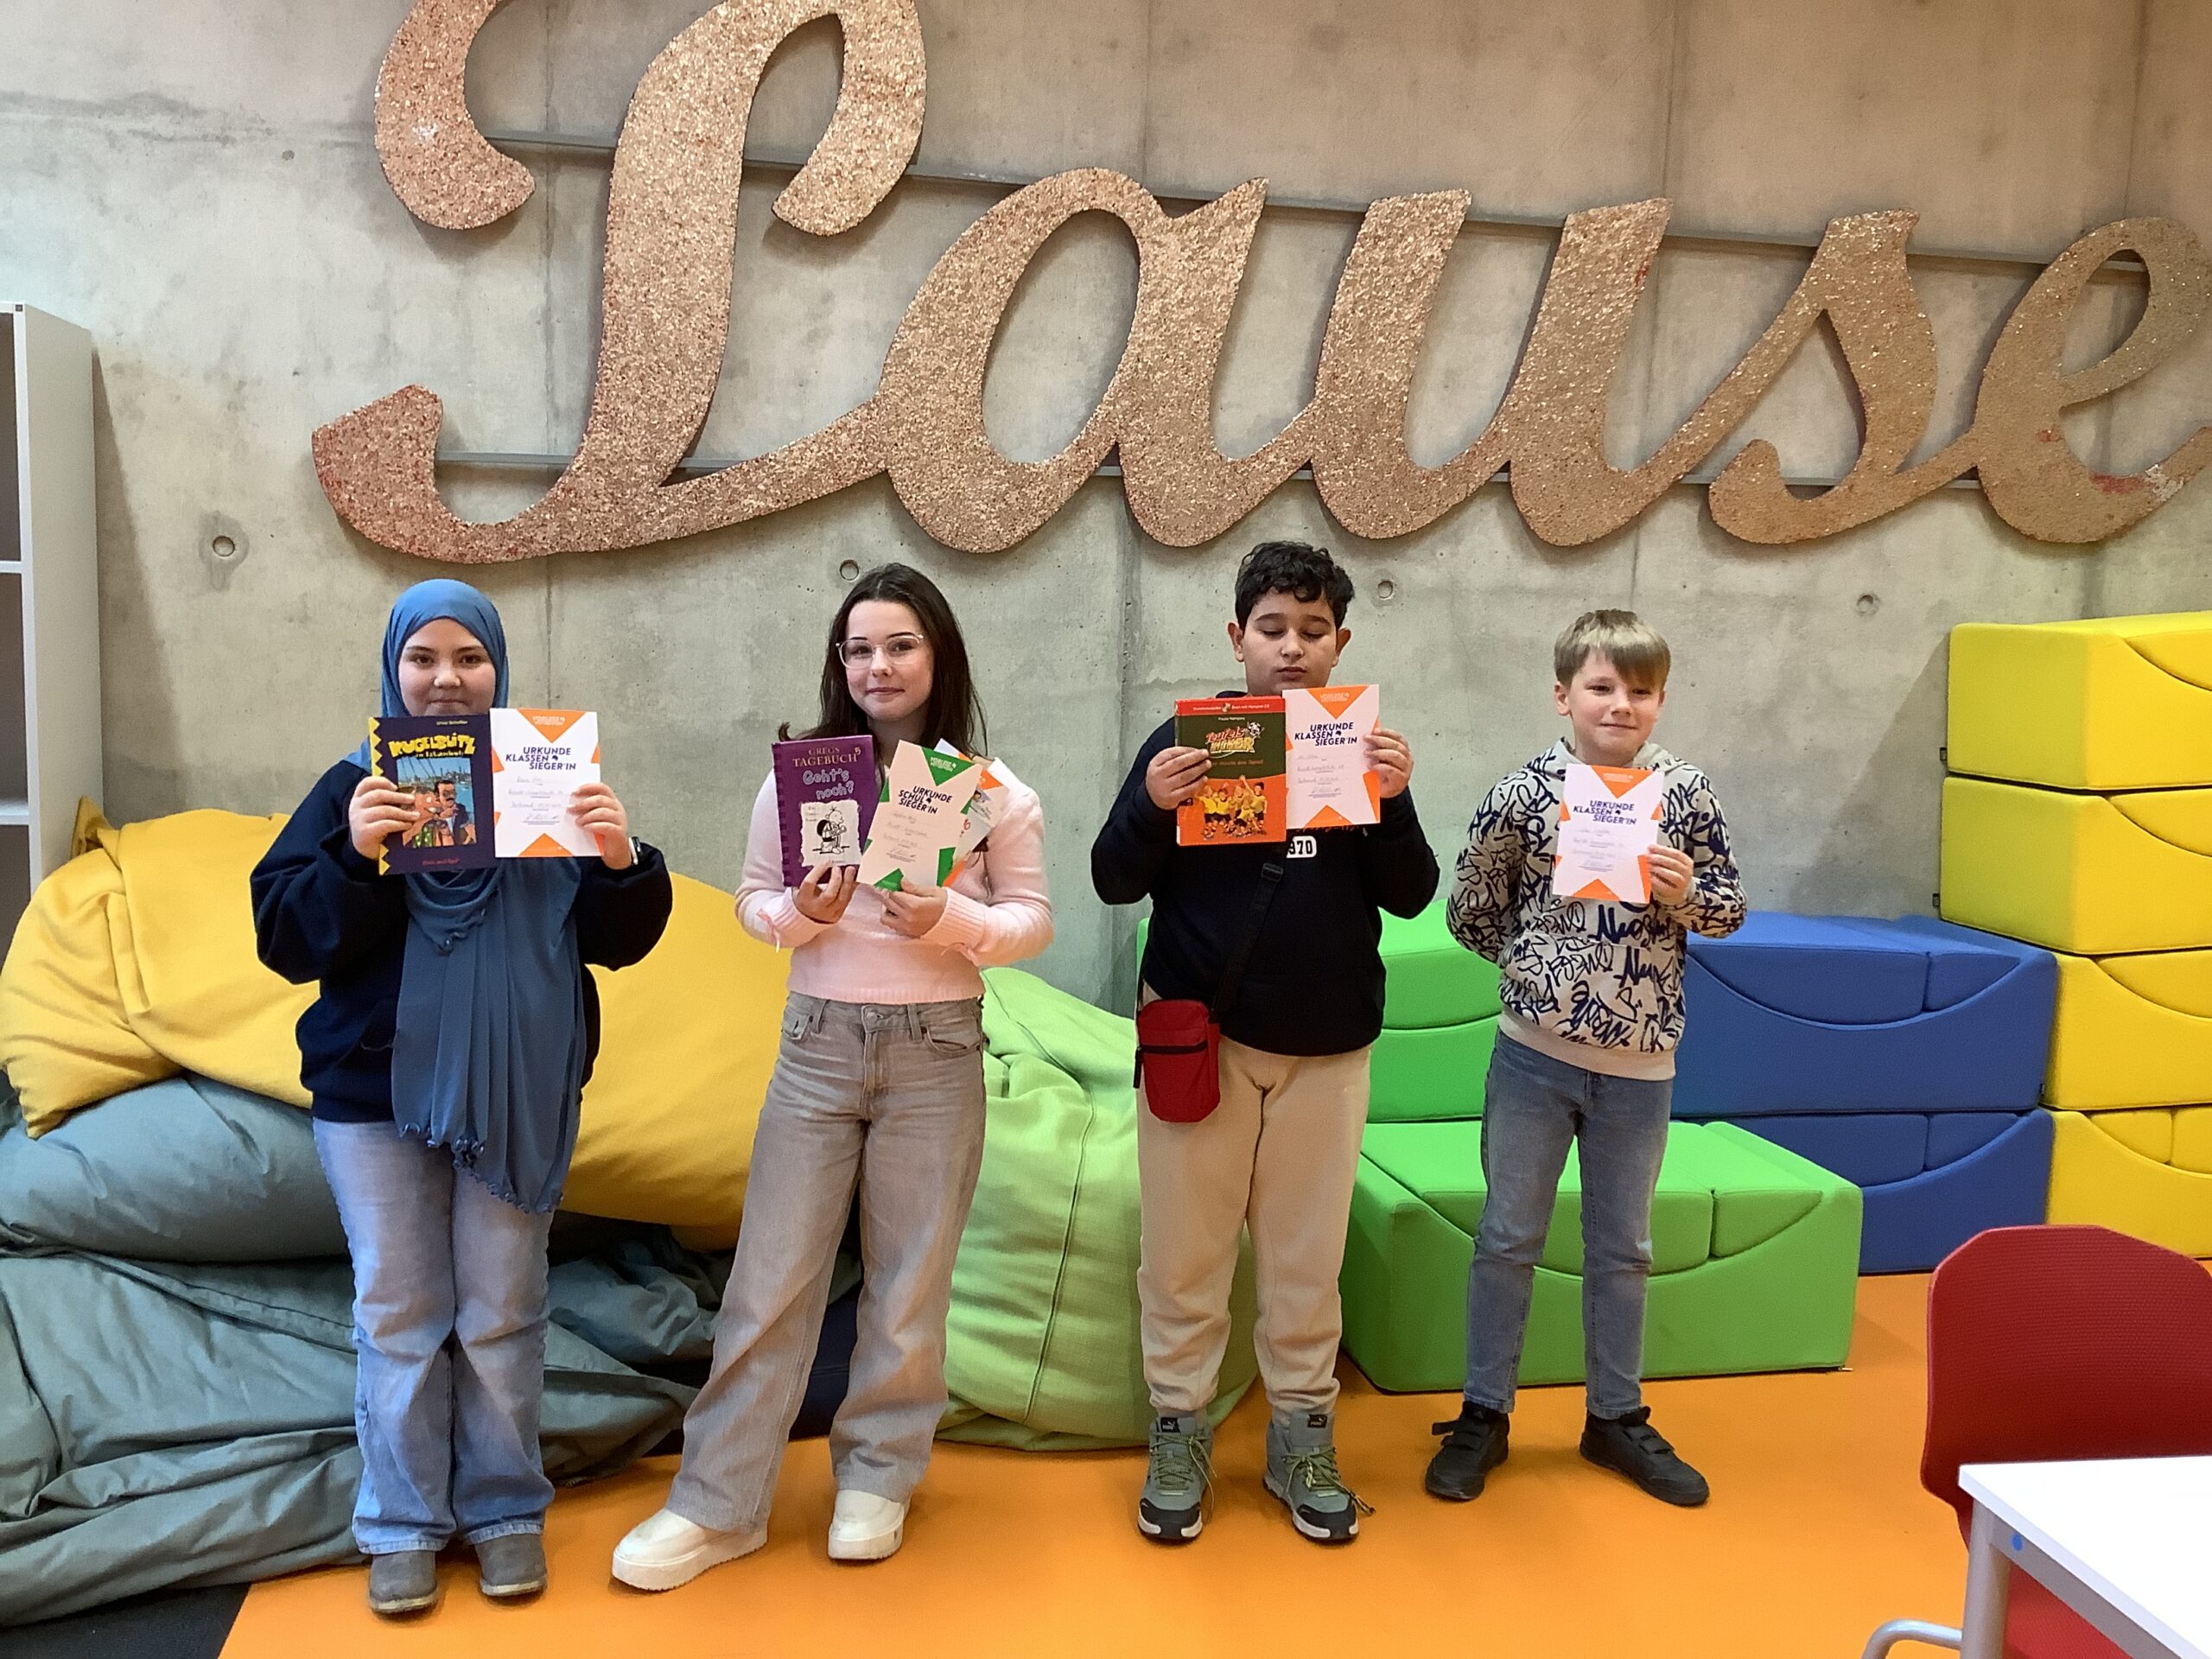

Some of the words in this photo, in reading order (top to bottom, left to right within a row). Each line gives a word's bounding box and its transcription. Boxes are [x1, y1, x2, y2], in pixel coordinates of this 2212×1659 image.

[1310, 721, 1354, 732] URKUNDE
[1294, 731, 1333, 741] KLASSEN
[523, 747, 571, 756] URKUNDE
[792, 753, 857, 767] TAGEBUCH
[854, 747, 861, 756] 5
[808, 747, 841, 756] GREGS
[505, 753, 549, 762] KLASSEN
[803, 767, 850, 785] Geht's
[816, 780, 855, 800] noch?
[912, 785, 953, 804] URKUNDE
[898, 789, 925, 804] SCHUL
[1573, 805, 1612, 815] KLASSEN
[1590, 799, 1635, 811] URKUNDE
